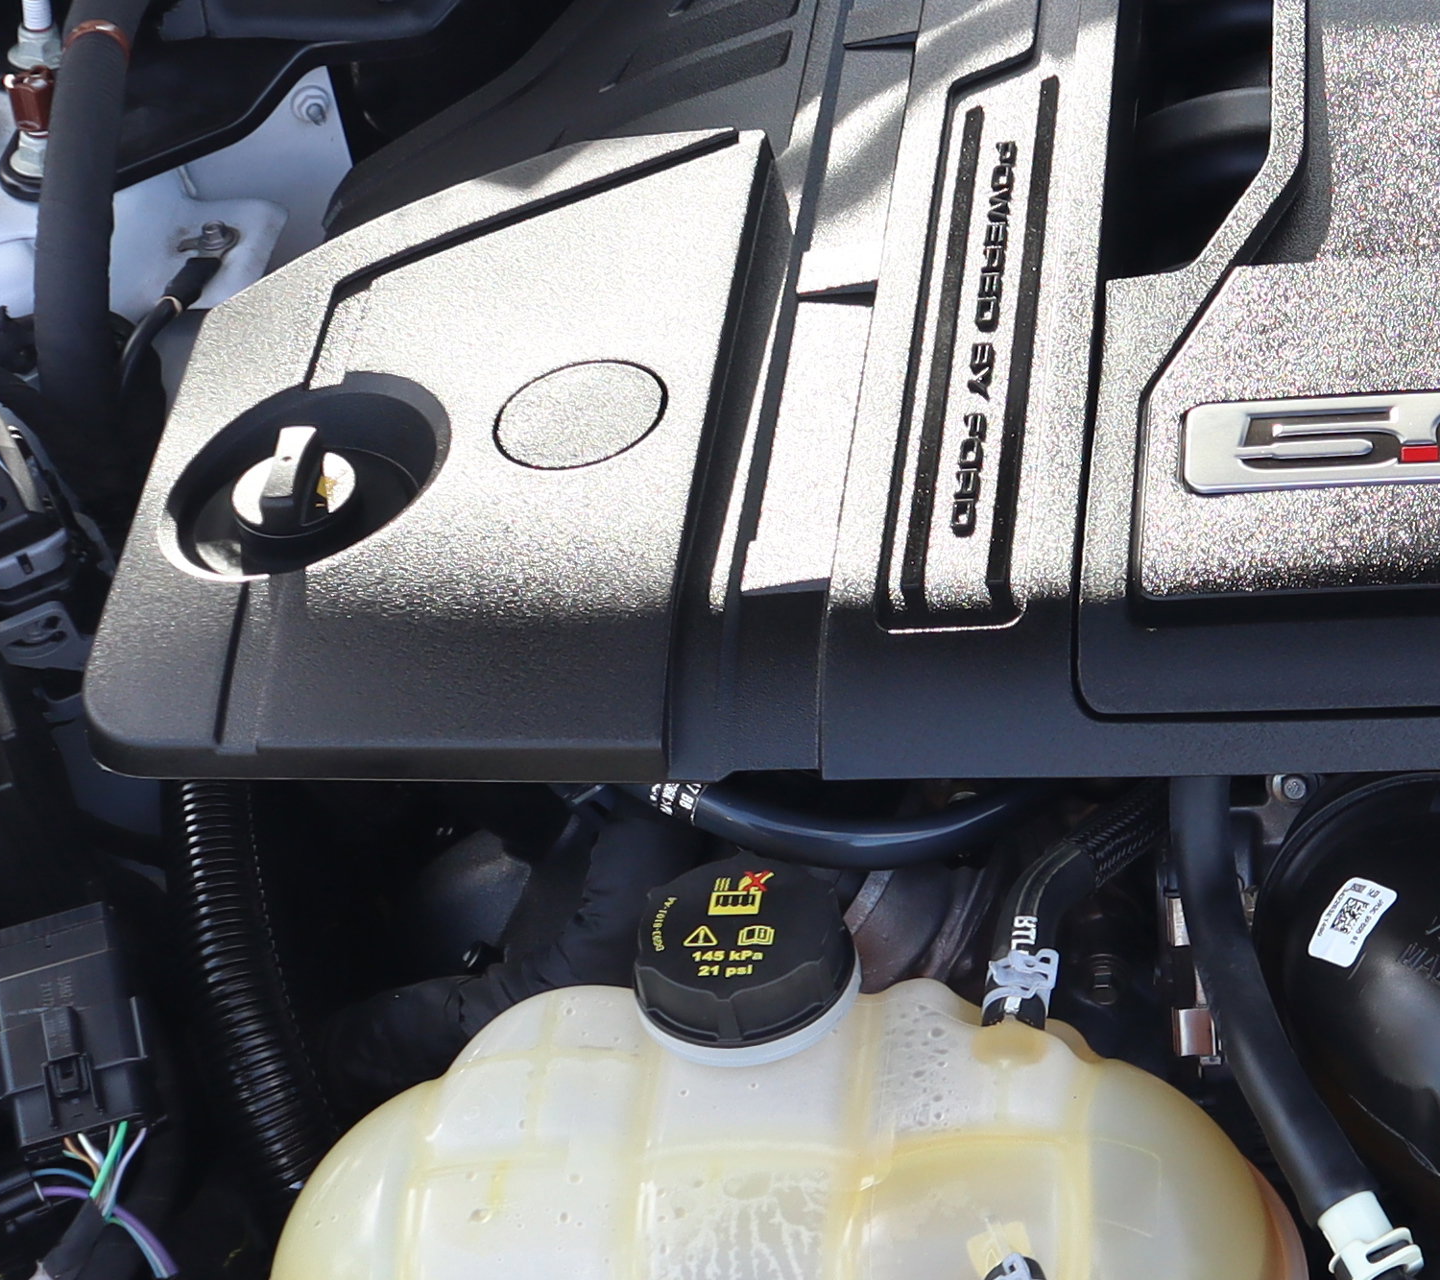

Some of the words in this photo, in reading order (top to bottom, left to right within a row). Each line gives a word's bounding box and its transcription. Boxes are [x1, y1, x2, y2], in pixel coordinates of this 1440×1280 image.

[974, 140, 1017, 332] POWERED
[968, 342, 997, 401] BY
[952, 413, 987, 538] FORD
[692, 951, 725, 962] 145
[729, 950, 764, 962] kPa
[1010, 915, 1040, 951] BTL
[697, 964, 720, 977] 21
[724, 963, 753, 978] psi
